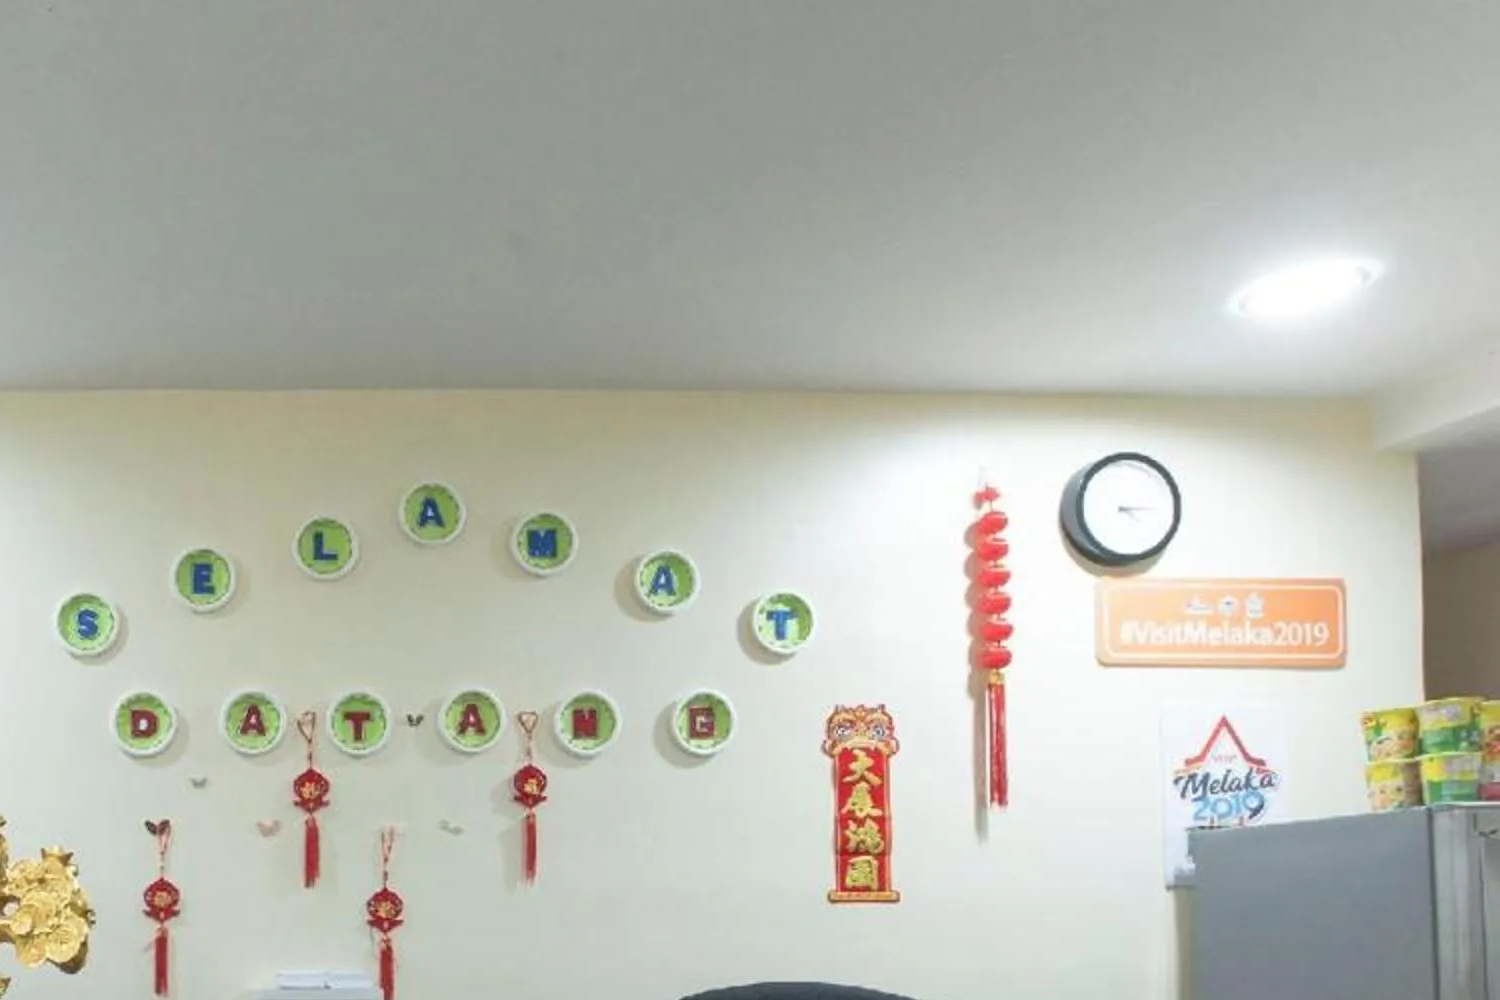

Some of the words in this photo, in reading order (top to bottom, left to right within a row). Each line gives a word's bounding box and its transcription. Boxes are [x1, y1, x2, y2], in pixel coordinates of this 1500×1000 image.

[74, 496, 796, 640] SELAMAT
[1120, 621, 1330, 646] #VisitMelaka2019
[1173, 767, 1279, 800] Melaka
[1192, 793, 1266, 821] 2019
